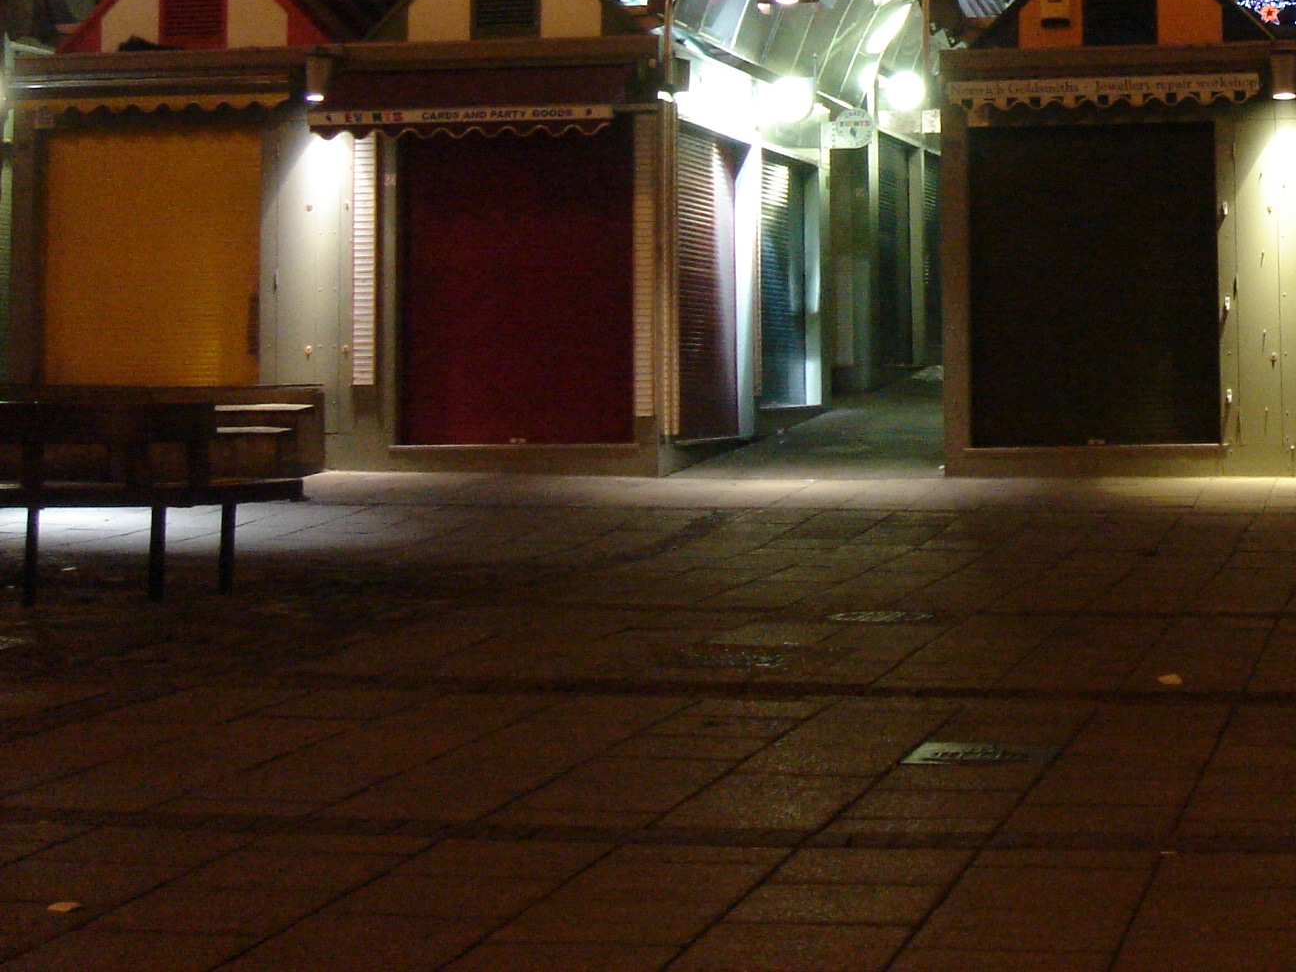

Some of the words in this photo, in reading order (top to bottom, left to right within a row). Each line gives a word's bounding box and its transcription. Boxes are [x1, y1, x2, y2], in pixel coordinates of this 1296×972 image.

[1008, 81, 1079, 93] Goldsmiths
[1197, 77, 1257, 90] workshop
[421, 112, 459, 121] CARDS
[464, 111, 486, 119] AND
[491, 110, 525, 118] PARTY
[532, 109, 572, 117] GOODS
